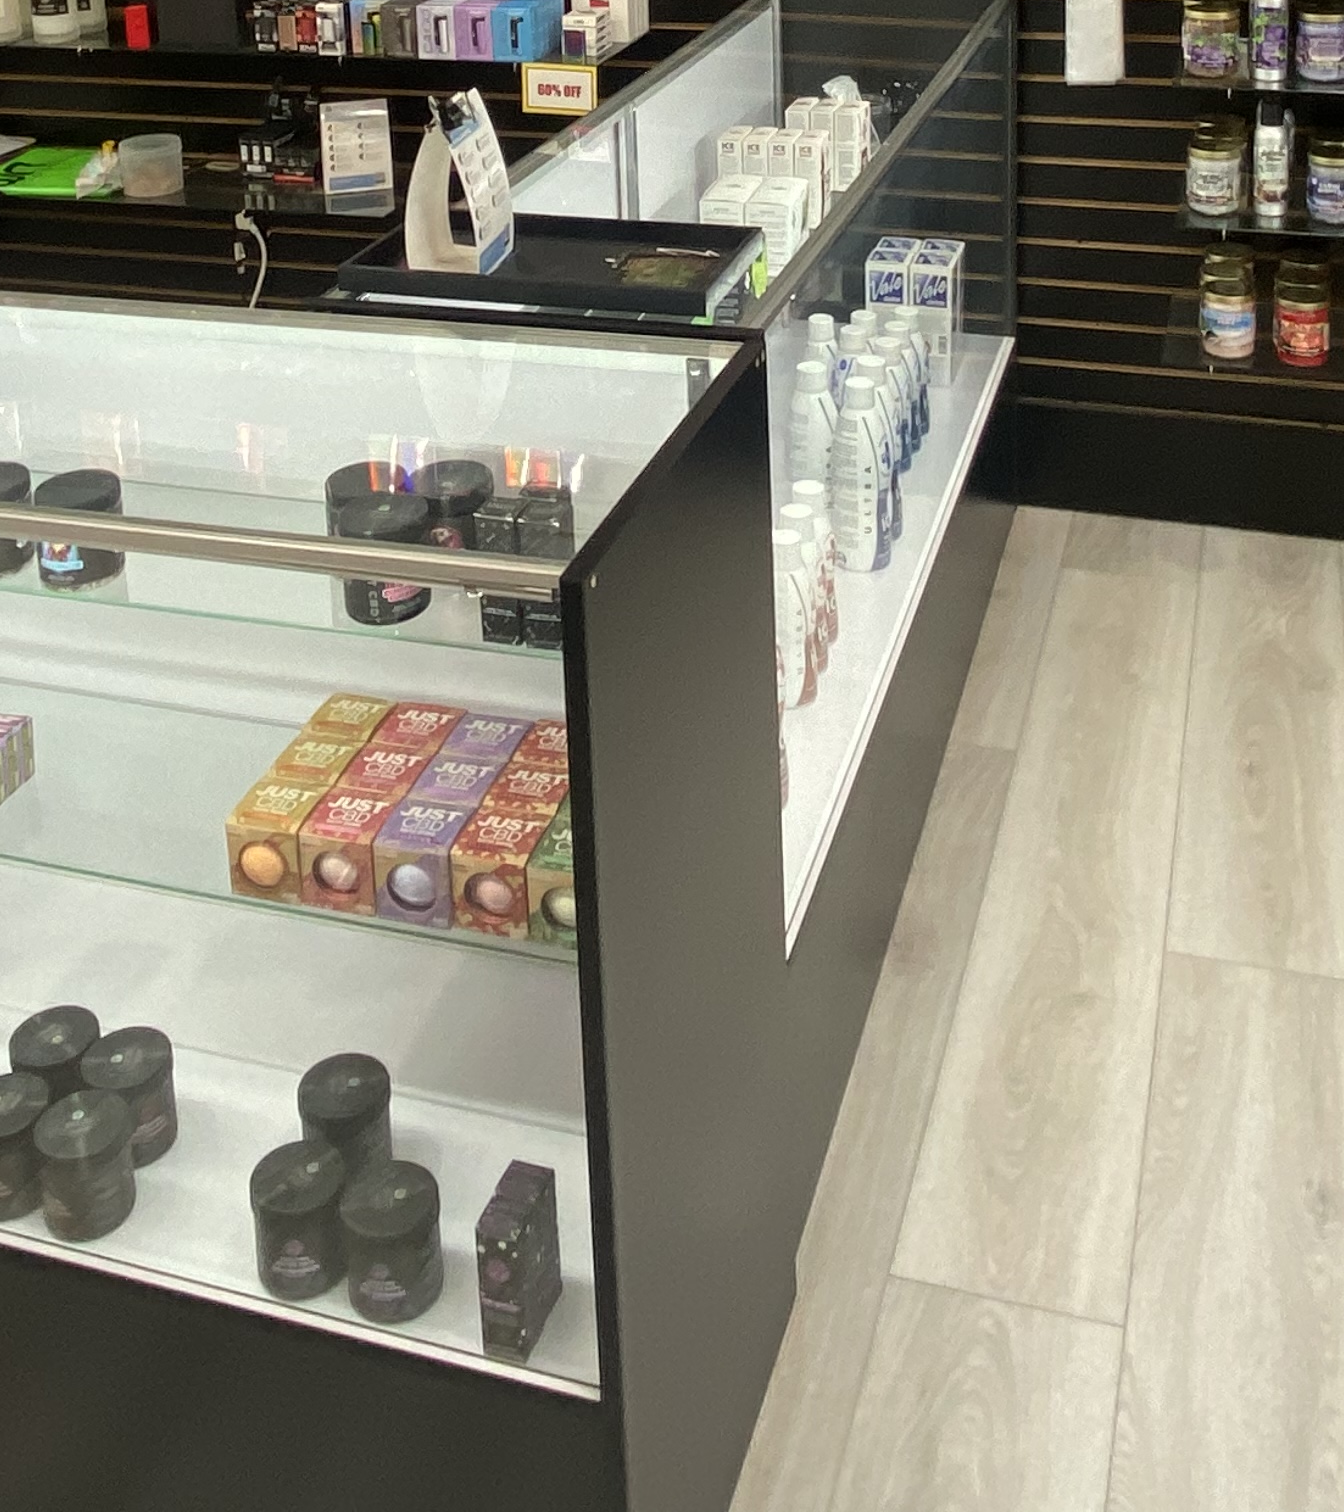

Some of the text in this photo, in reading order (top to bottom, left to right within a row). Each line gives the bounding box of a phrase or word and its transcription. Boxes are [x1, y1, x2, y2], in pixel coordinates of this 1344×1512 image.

[537, 83, 582, 98] 60% OFF
[863, 466, 872, 534] ULTRA
[398, 709, 455, 725] JUST
[398, 719, 438, 733] CBD
[465, 719, 524, 734] JUST
[295, 741, 352, 756] JUST
[363, 751, 423, 767] JUST
[365, 762, 406, 776] CBD
[434, 761, 495, 778] JUST
[256, 785, 317, 802] JUST
[256, 796, 297, 811] CBD
[328, 796, 390, 814] JUST
[328, 808, 371, 824] CBD
[400, 806, 464, 822] JUST
[401, 818, 445, 833] CBD
[478, 815, 541, 833] JUST
[479, 827, 523, 842] CBD
